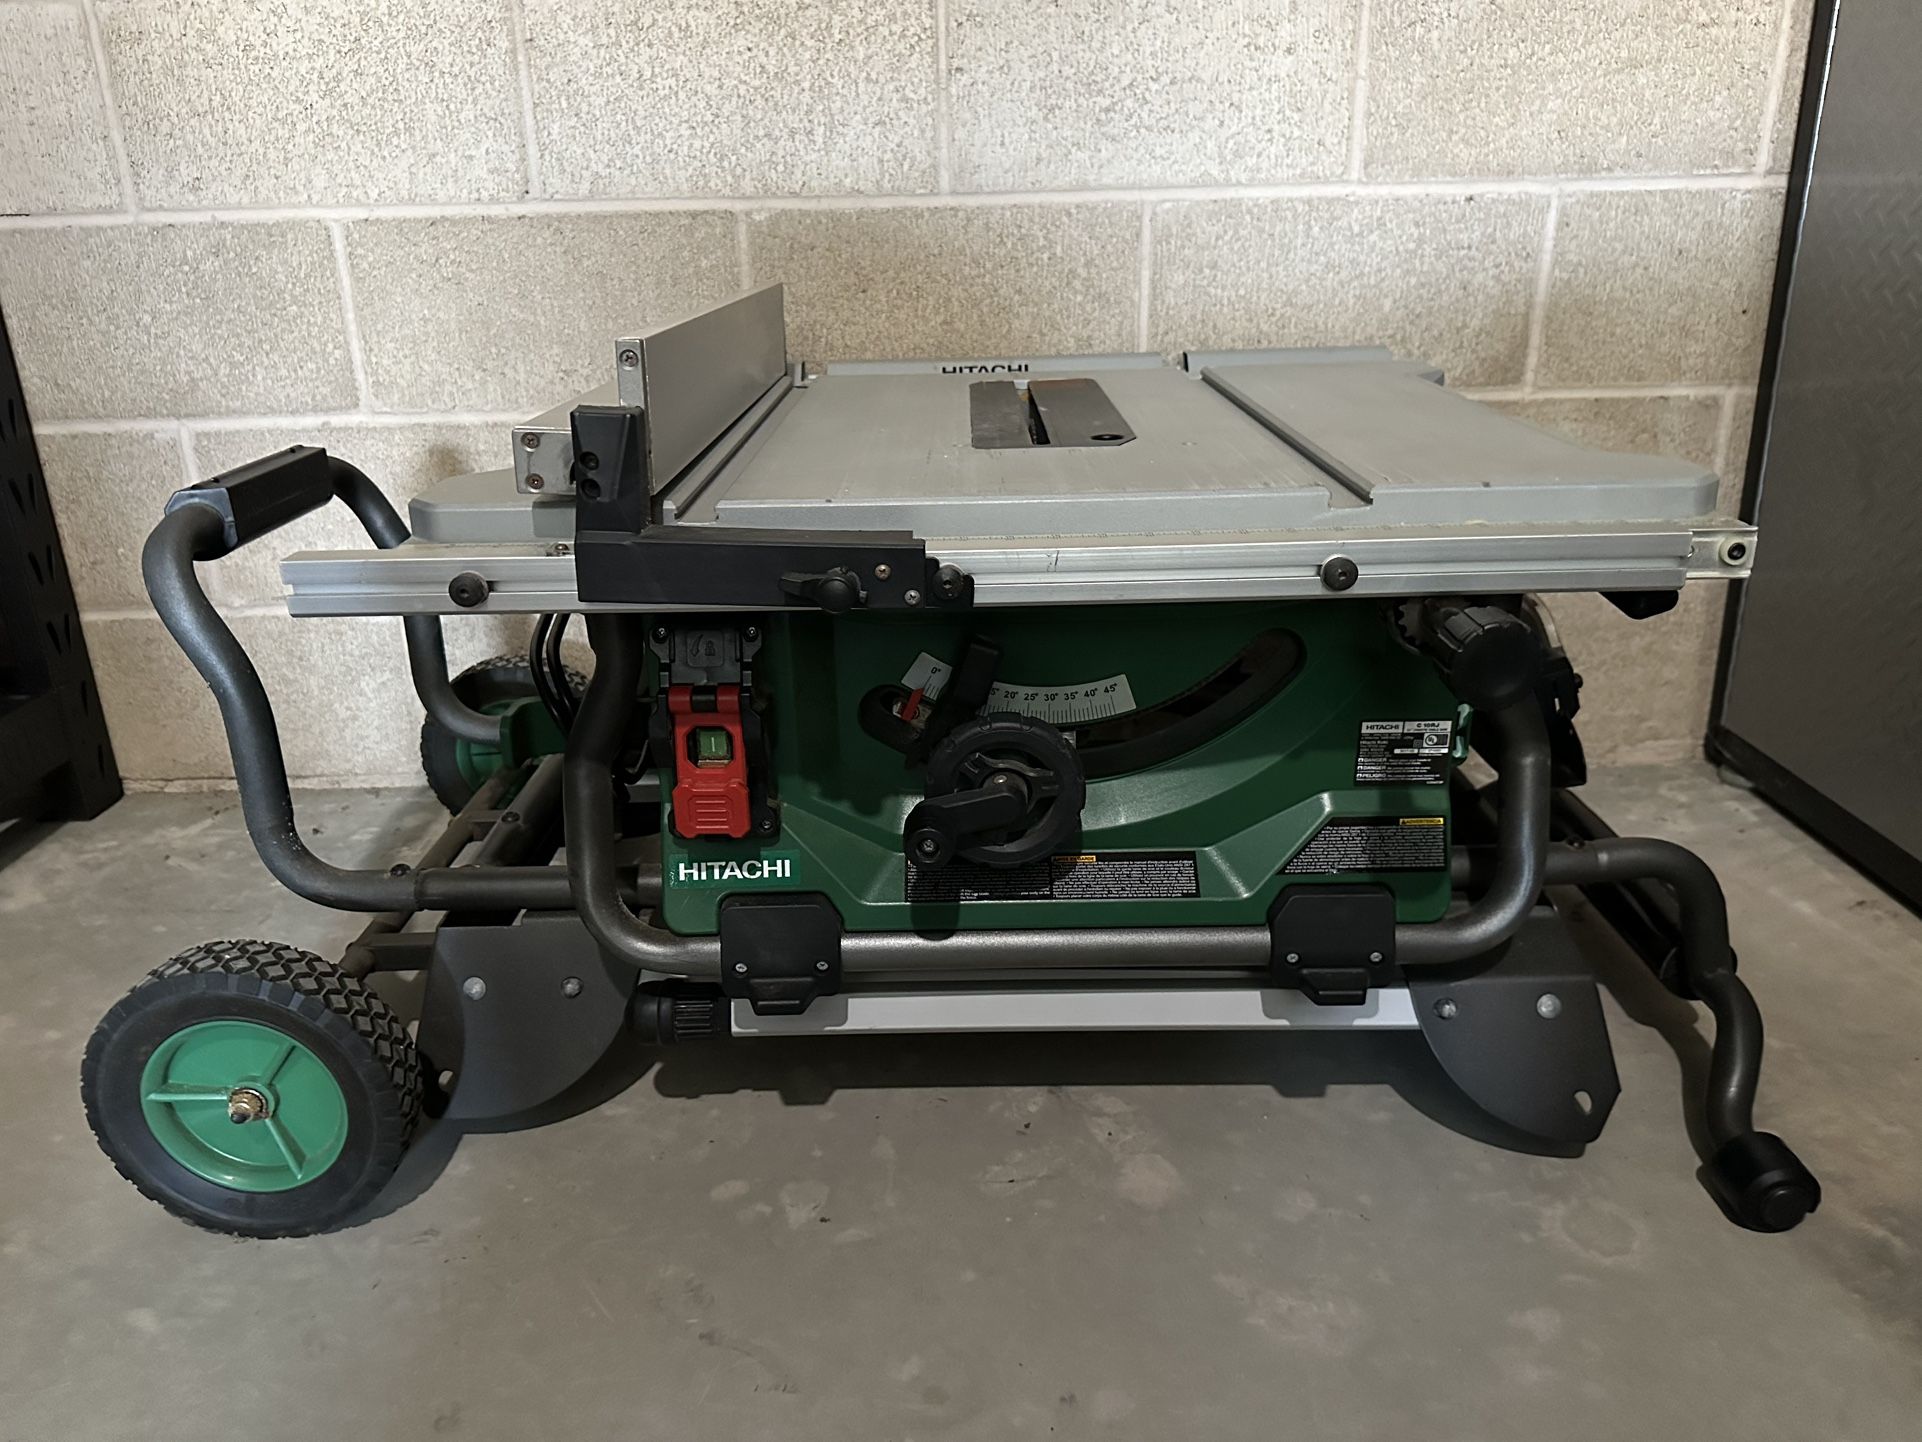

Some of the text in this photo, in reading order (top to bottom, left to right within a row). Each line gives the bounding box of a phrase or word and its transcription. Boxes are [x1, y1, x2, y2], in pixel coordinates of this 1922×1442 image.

[931, 666, 1118, 702] 0° 5° 20° 25° 30° 35° 40° 45°
[678, 859, 791, 882] HITACHI
